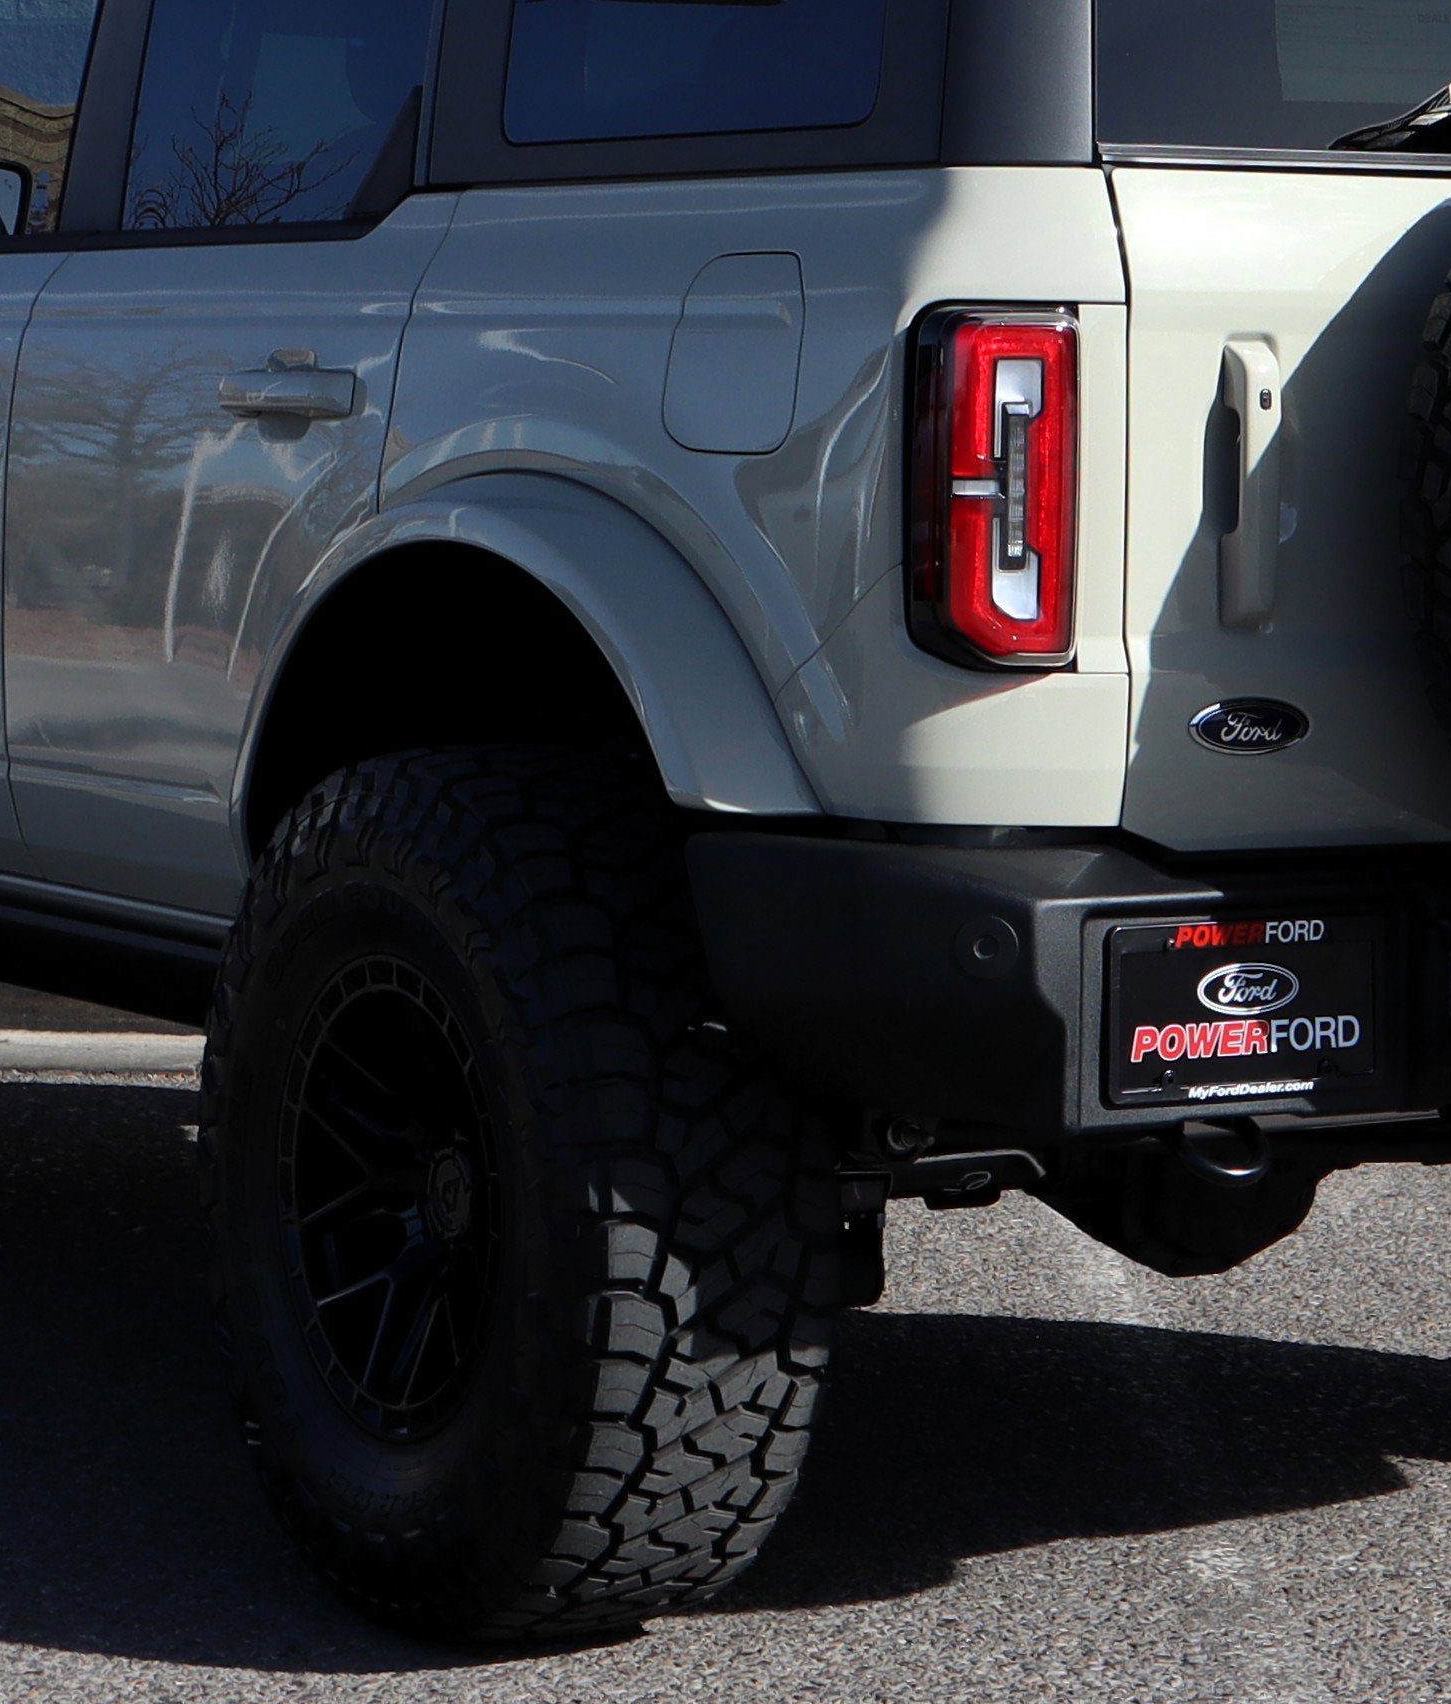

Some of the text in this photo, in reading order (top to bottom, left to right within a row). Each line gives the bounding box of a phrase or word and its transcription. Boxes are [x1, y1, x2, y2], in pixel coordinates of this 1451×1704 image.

[1220, 711, 1282, 743] Ford
[1173, 919, 1326, 949] POWERFORD
[1217, 969, 1278, 1004] Ford
[1130, 1015, 1361, 1063] POWERFORD
[1187, 1080, 1315, 1100] MyFordDealer.com
